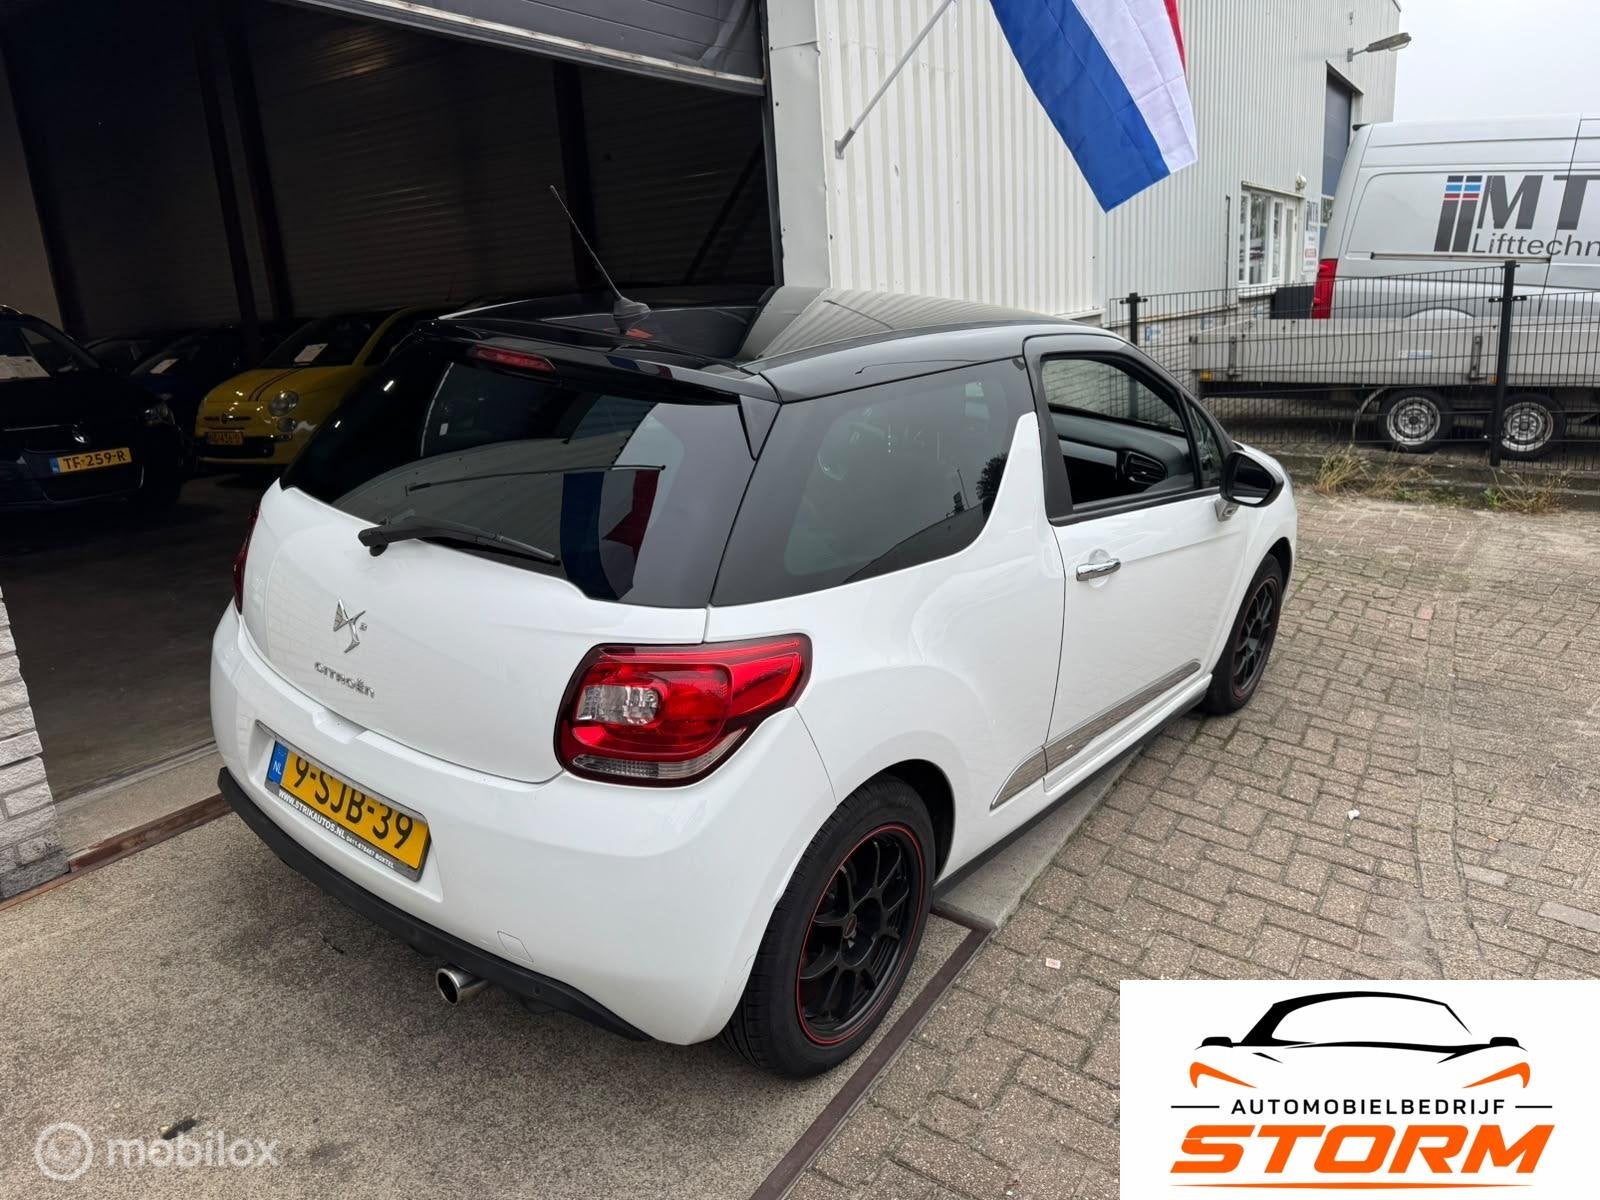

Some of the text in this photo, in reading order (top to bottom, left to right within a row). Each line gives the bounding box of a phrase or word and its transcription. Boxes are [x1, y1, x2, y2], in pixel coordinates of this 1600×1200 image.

[62, 450, 126, 470] TF-259-R
[272, 761, 282, 775] NL
[278, 789, 346, 840] WWW.STRIKAUTOS.NL
[294, 755, 414, 850] 9-SJB-39
